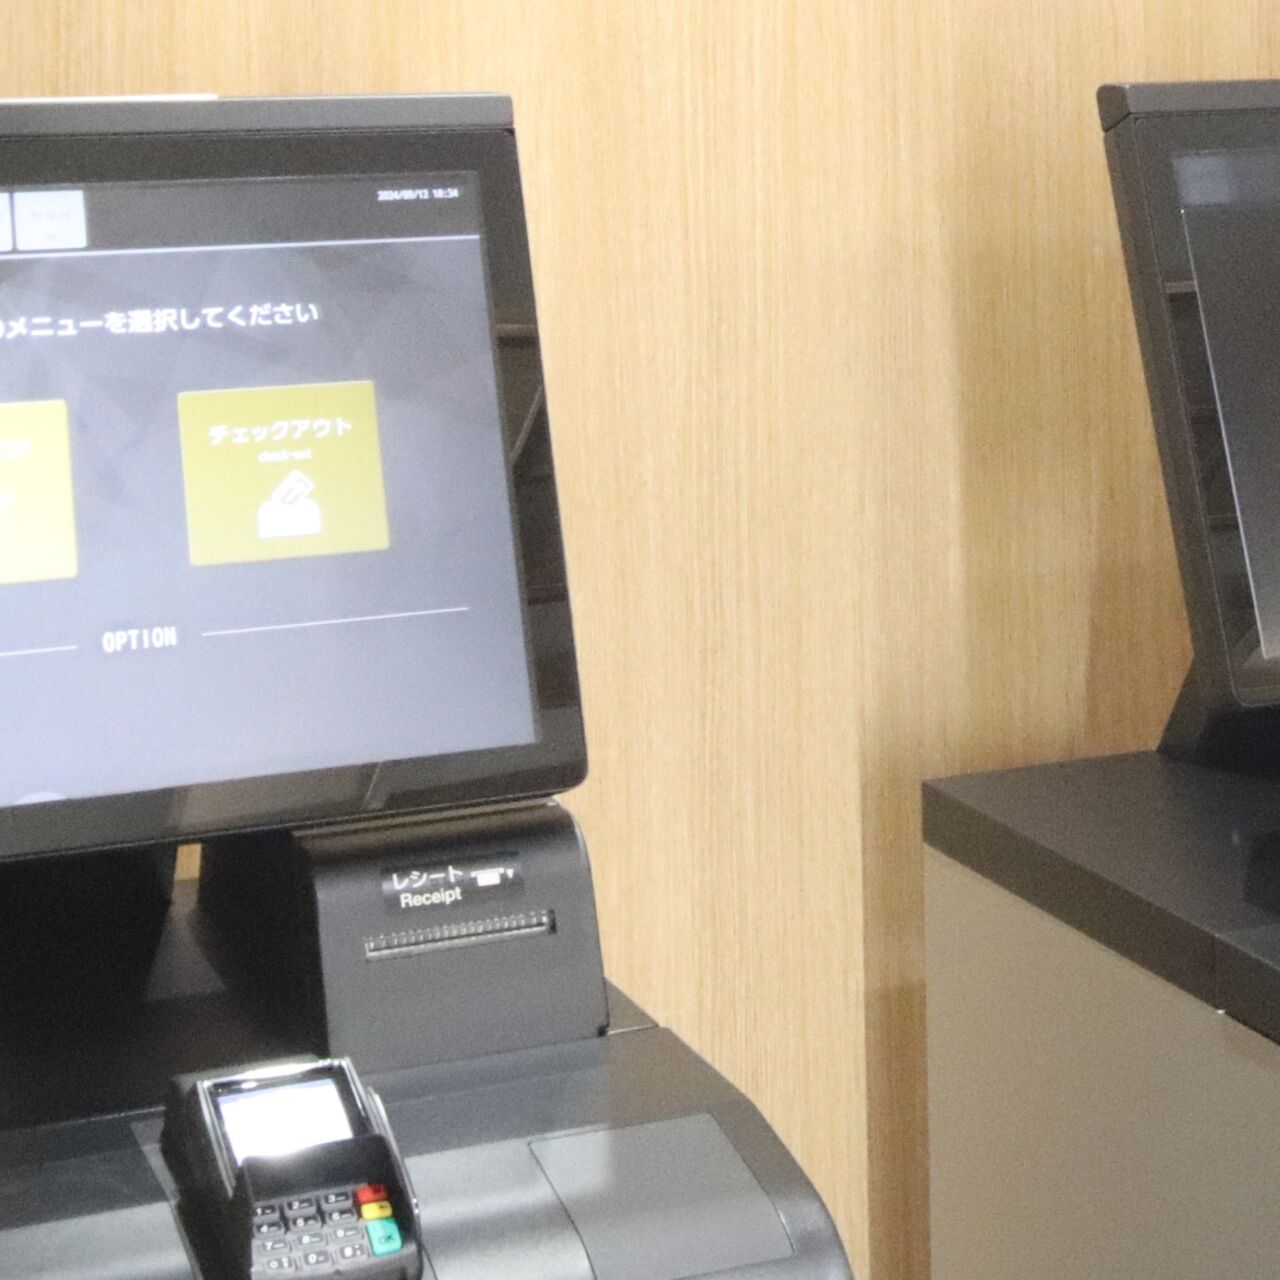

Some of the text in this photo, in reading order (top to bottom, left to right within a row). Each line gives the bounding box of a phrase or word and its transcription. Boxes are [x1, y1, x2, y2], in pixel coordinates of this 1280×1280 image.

[208, 417, 353, 446] チェックアウト
[102, 626, 177, 653] OPTION
[392, 865, 464, 890] レシート
[399, 886, 463, 909] Receipt
